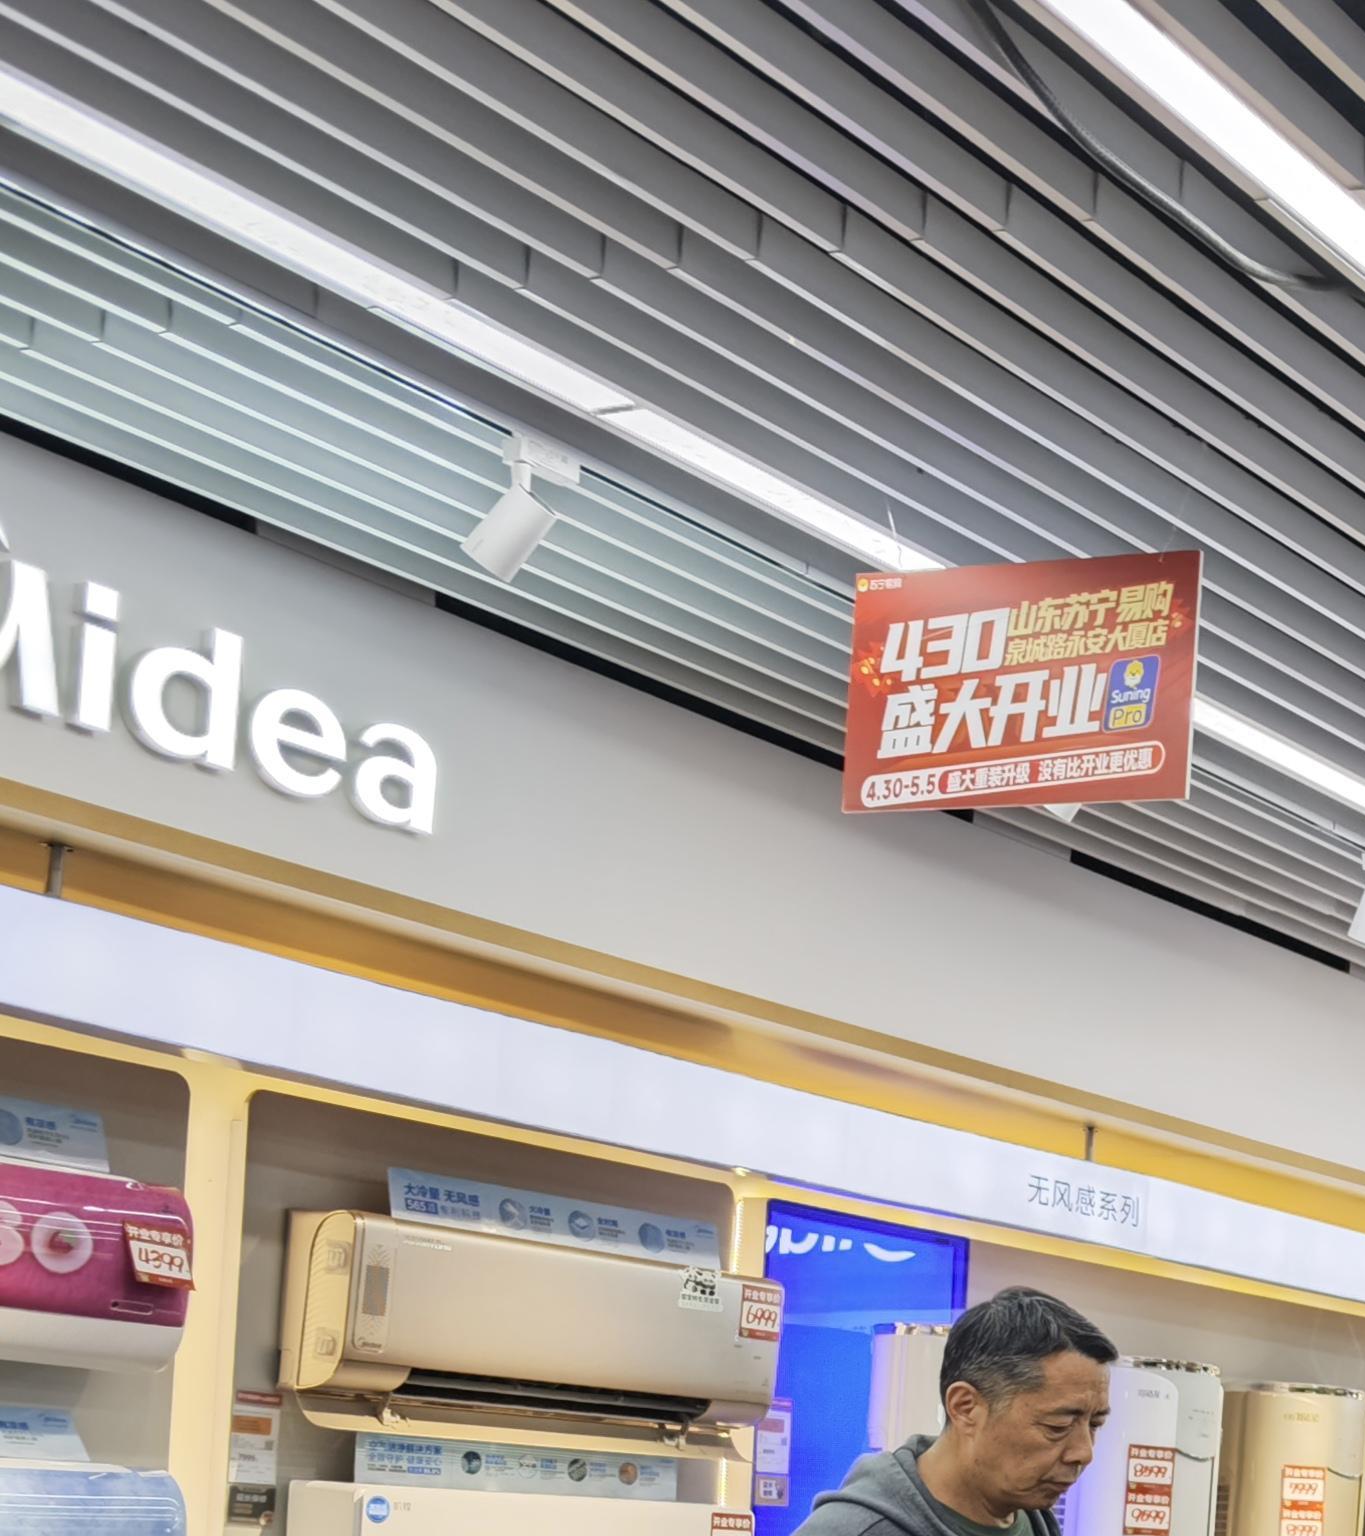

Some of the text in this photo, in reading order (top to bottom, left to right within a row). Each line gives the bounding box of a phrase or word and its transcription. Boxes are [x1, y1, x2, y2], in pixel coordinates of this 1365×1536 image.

[1007, 582, 1174, 637] 山东苏宁易购
[880, 608, 1011, 681] 430
[1005, 619, 1169, 665] 泉城路永安大厦店
[877, 663, 1107, 759] 盛大开业
[1111, 687, 1151, 705] Suning
[1112, 708, 1143, 729] Pro
[866, 749, 1153, 801] 4.30-5.5 盛大重装升级 没有比开业更优惠
[1028, 1174, 1140, 1227] 无风感系列
[138, 1247, 184, 1272] 4399
